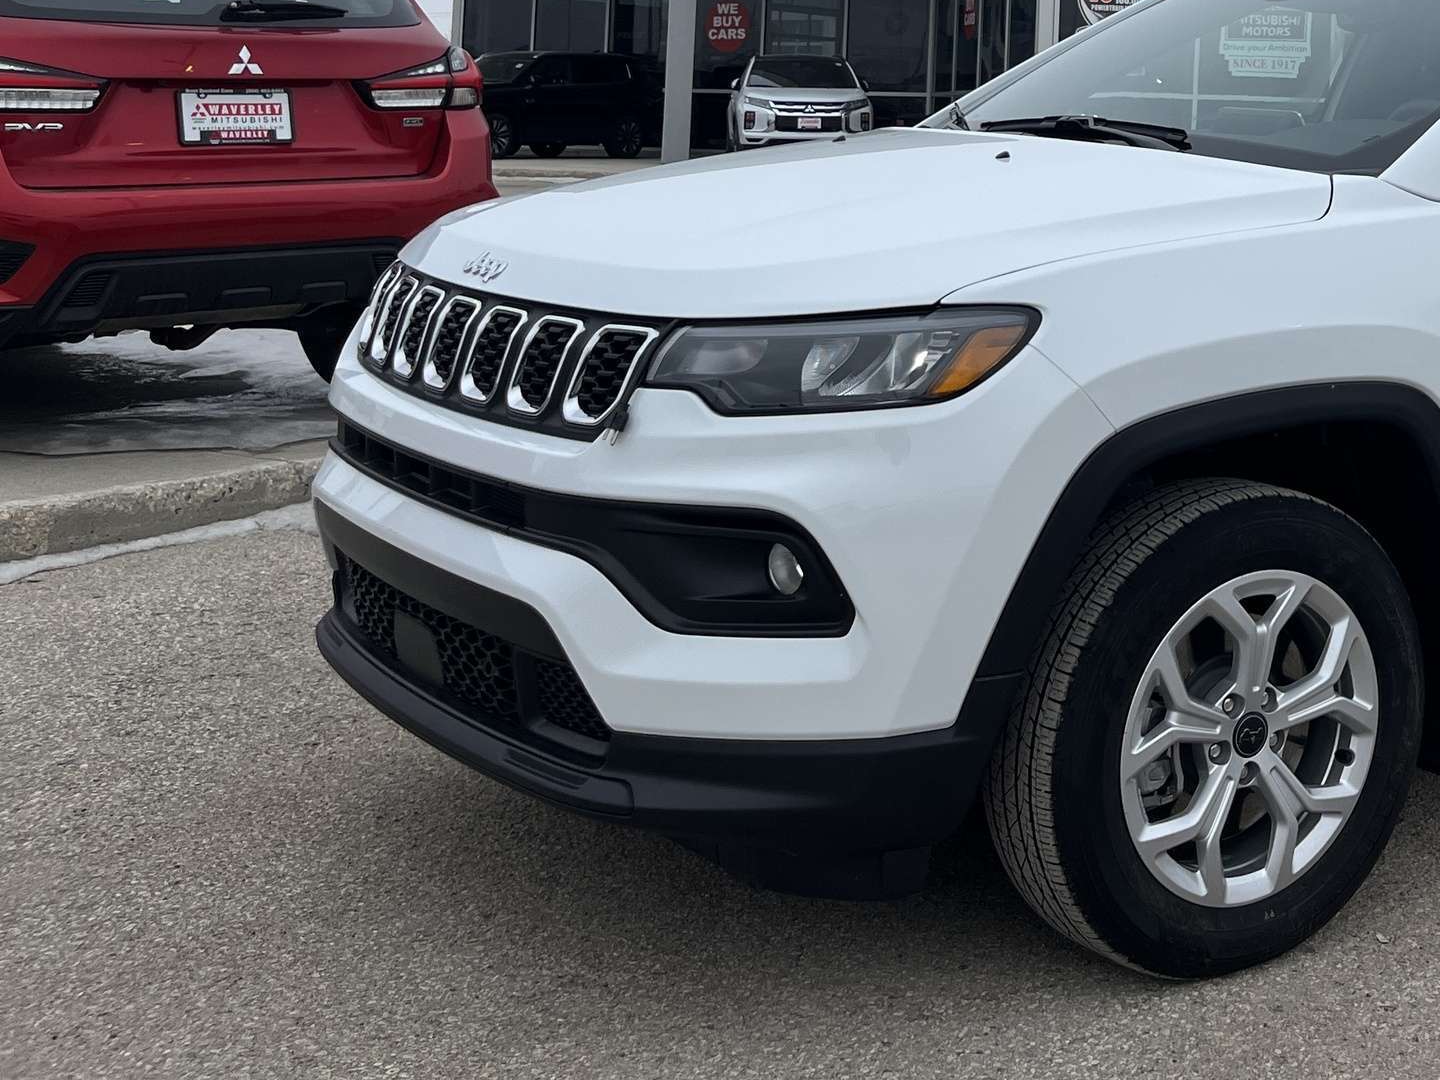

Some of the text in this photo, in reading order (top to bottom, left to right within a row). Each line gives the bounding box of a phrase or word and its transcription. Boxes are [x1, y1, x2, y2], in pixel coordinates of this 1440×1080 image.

[717, 3, 739, 15] WE
[712, 15, 742, 27] BUY
[708, 28, 746, 40] CARS
[208, 104, 281, 116] WAVERLEY
[210, 116, 283, 124] MITSUBISHI
